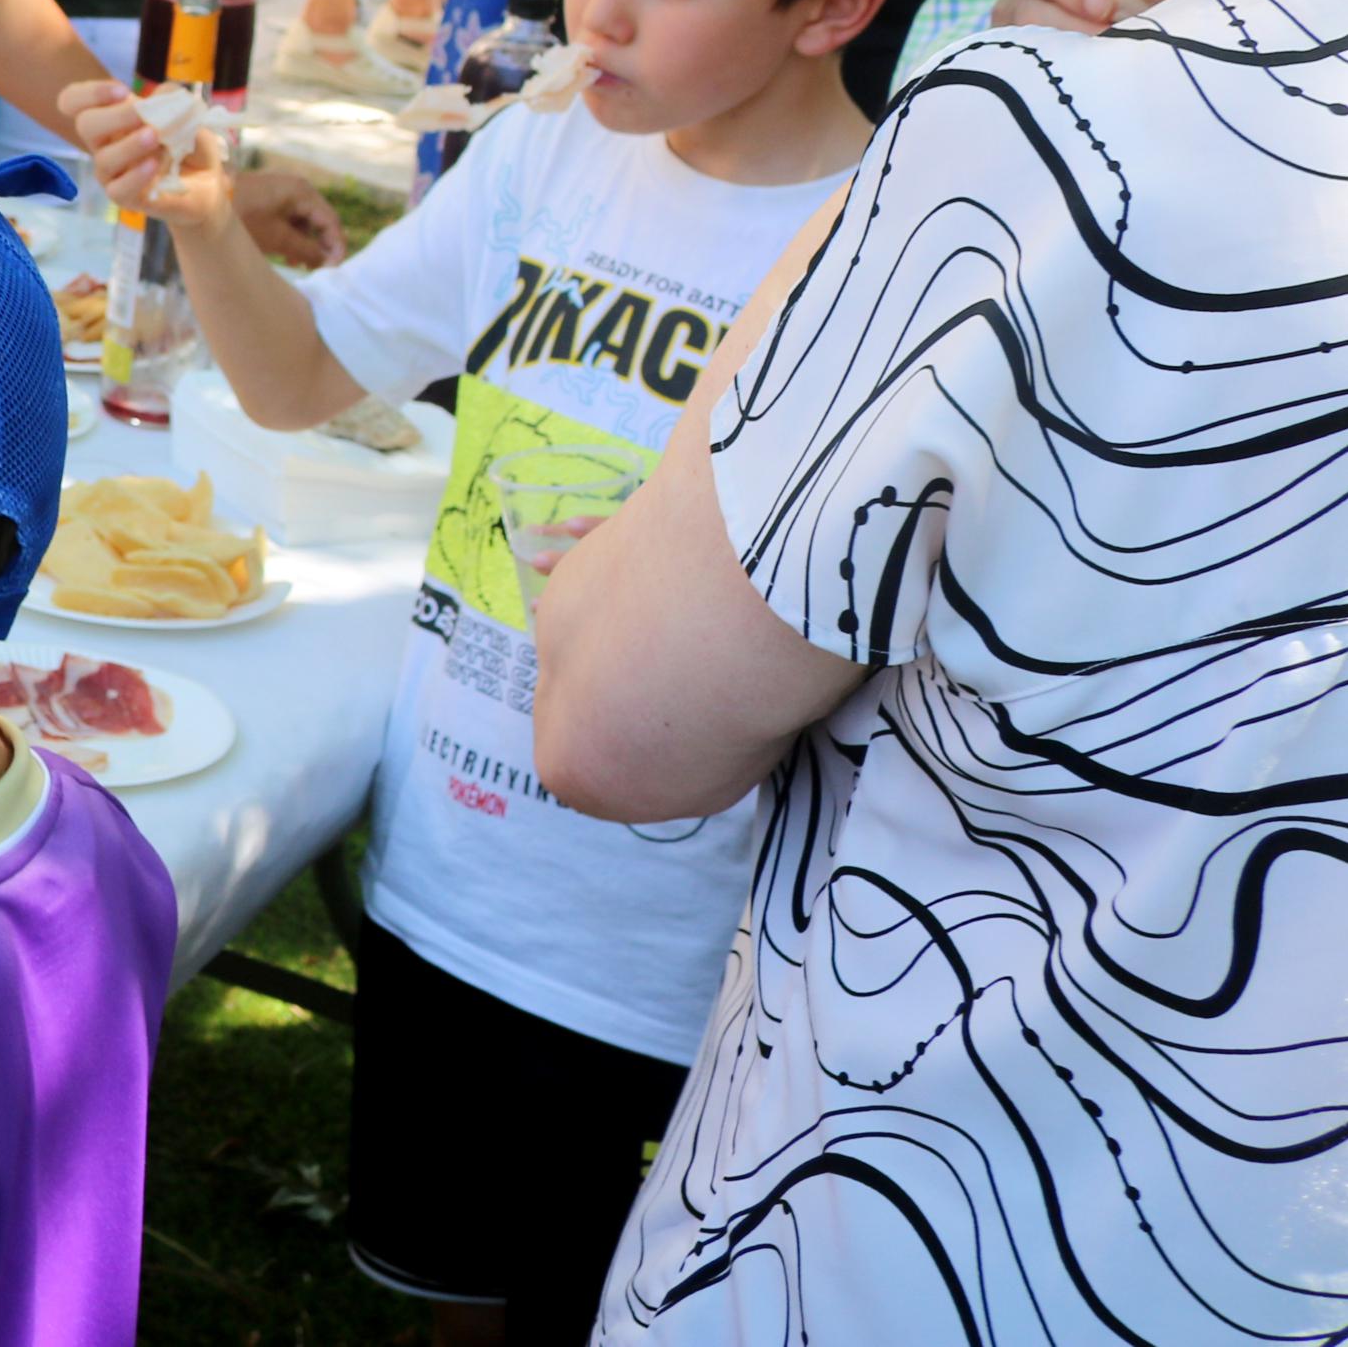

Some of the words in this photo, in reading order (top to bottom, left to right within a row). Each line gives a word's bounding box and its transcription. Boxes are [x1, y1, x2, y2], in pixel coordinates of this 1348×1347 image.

[465, 255, 730, 407] PIKAC
[585, 251, 644, 282] READY
[645, 273, 685, 298] FOR
[687, 287, 743, 318] BATT
